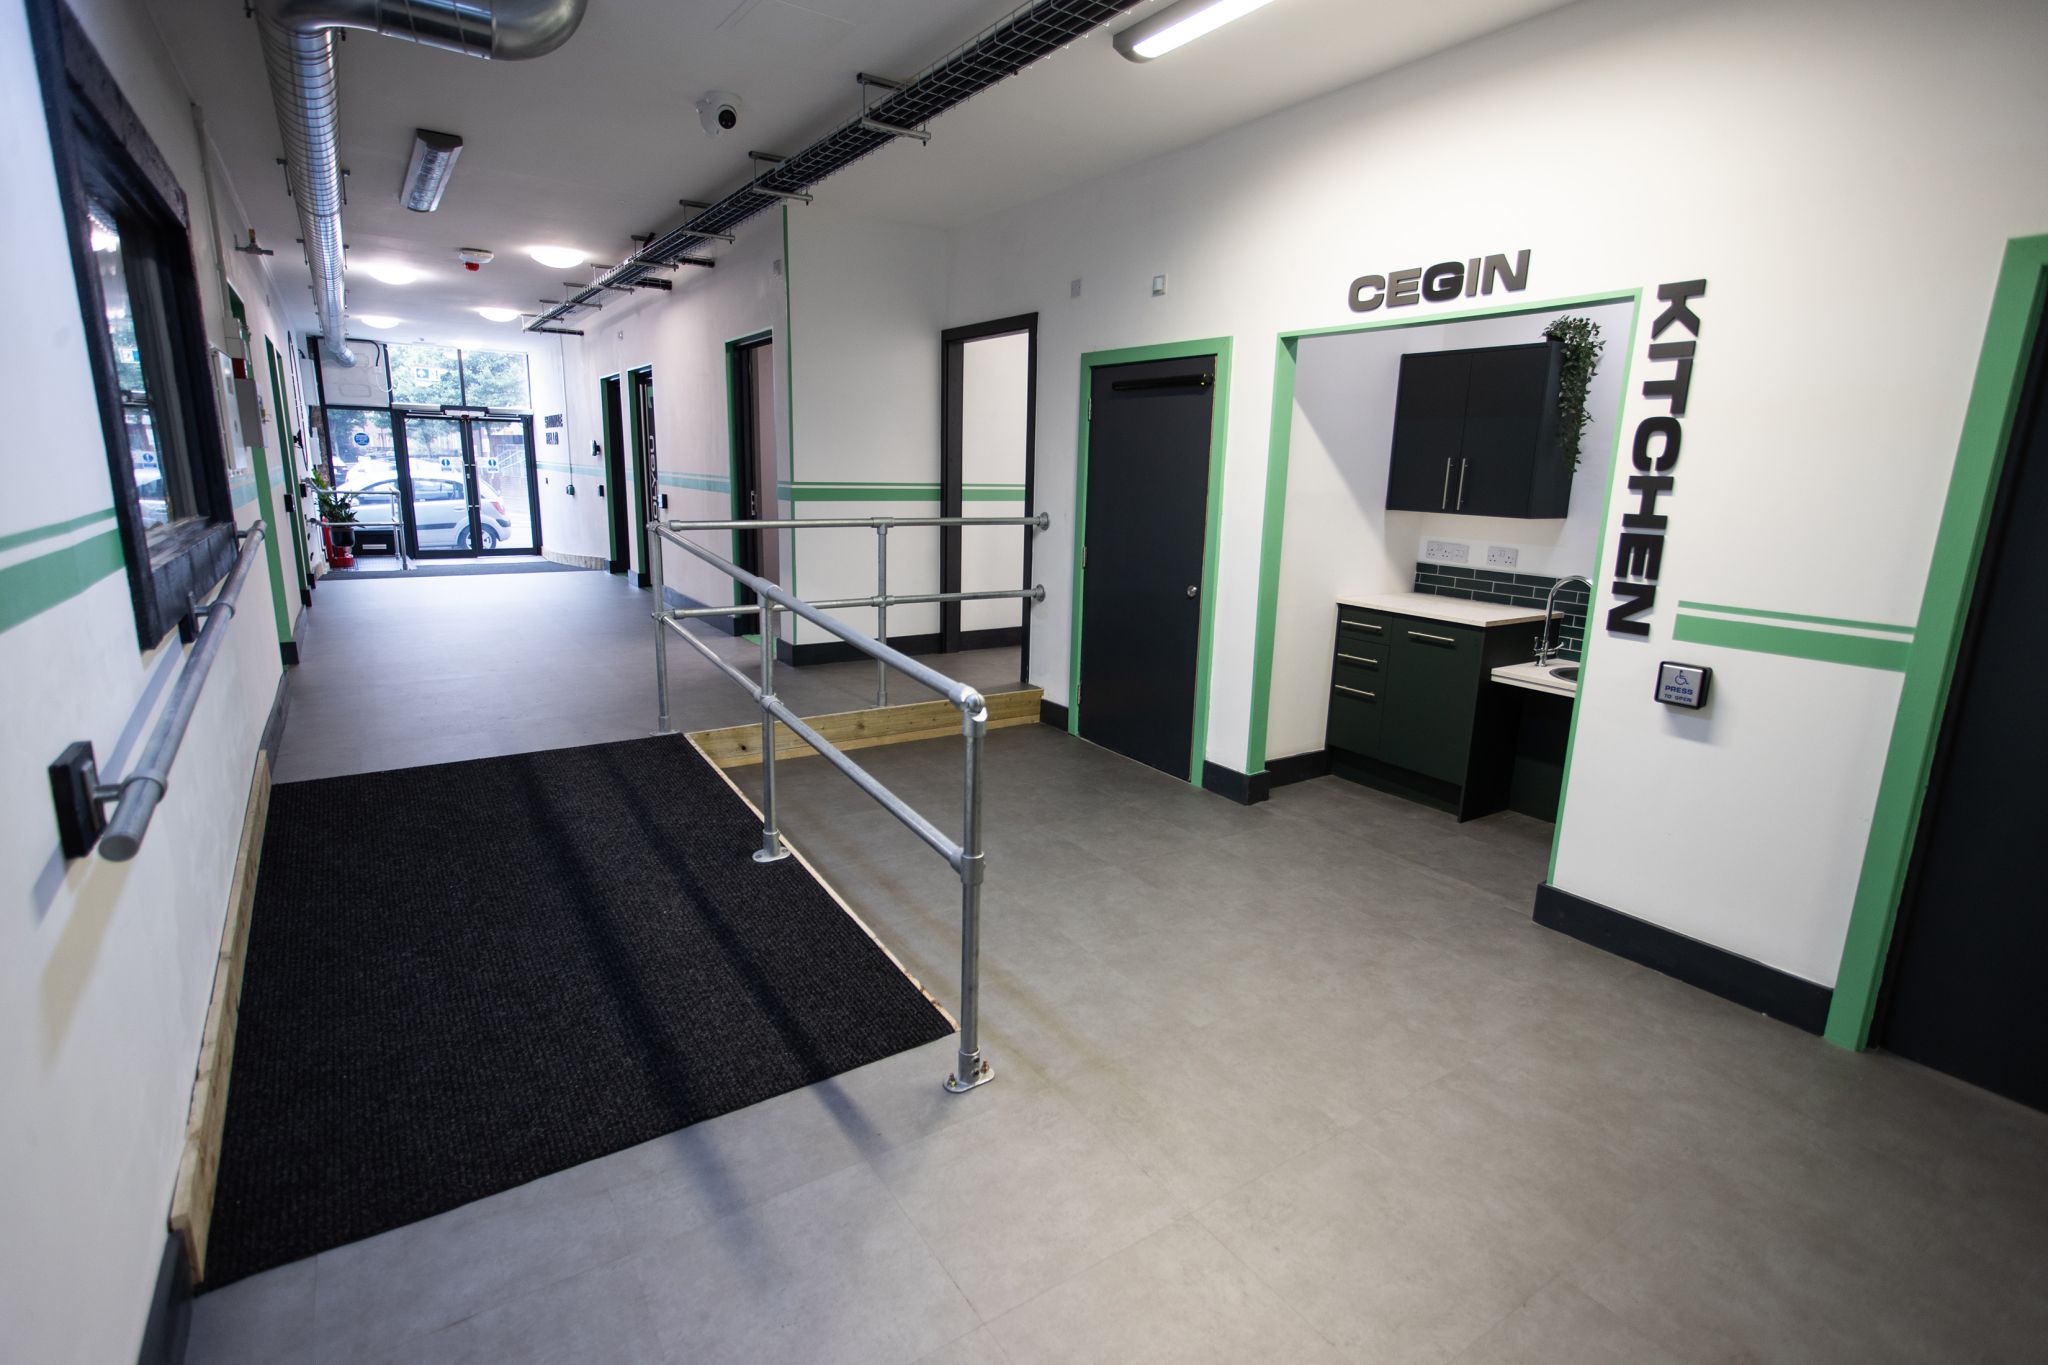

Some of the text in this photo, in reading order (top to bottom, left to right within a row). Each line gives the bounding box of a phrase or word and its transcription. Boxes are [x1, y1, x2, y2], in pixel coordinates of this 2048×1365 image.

[1349, 249, 1531, 311] CEGIN
[1606, 278, 1707, 639] KITCHEN
[1664, 684, 1694, 696] PRESS
[1674, 695, 1693, 703] OPEN
